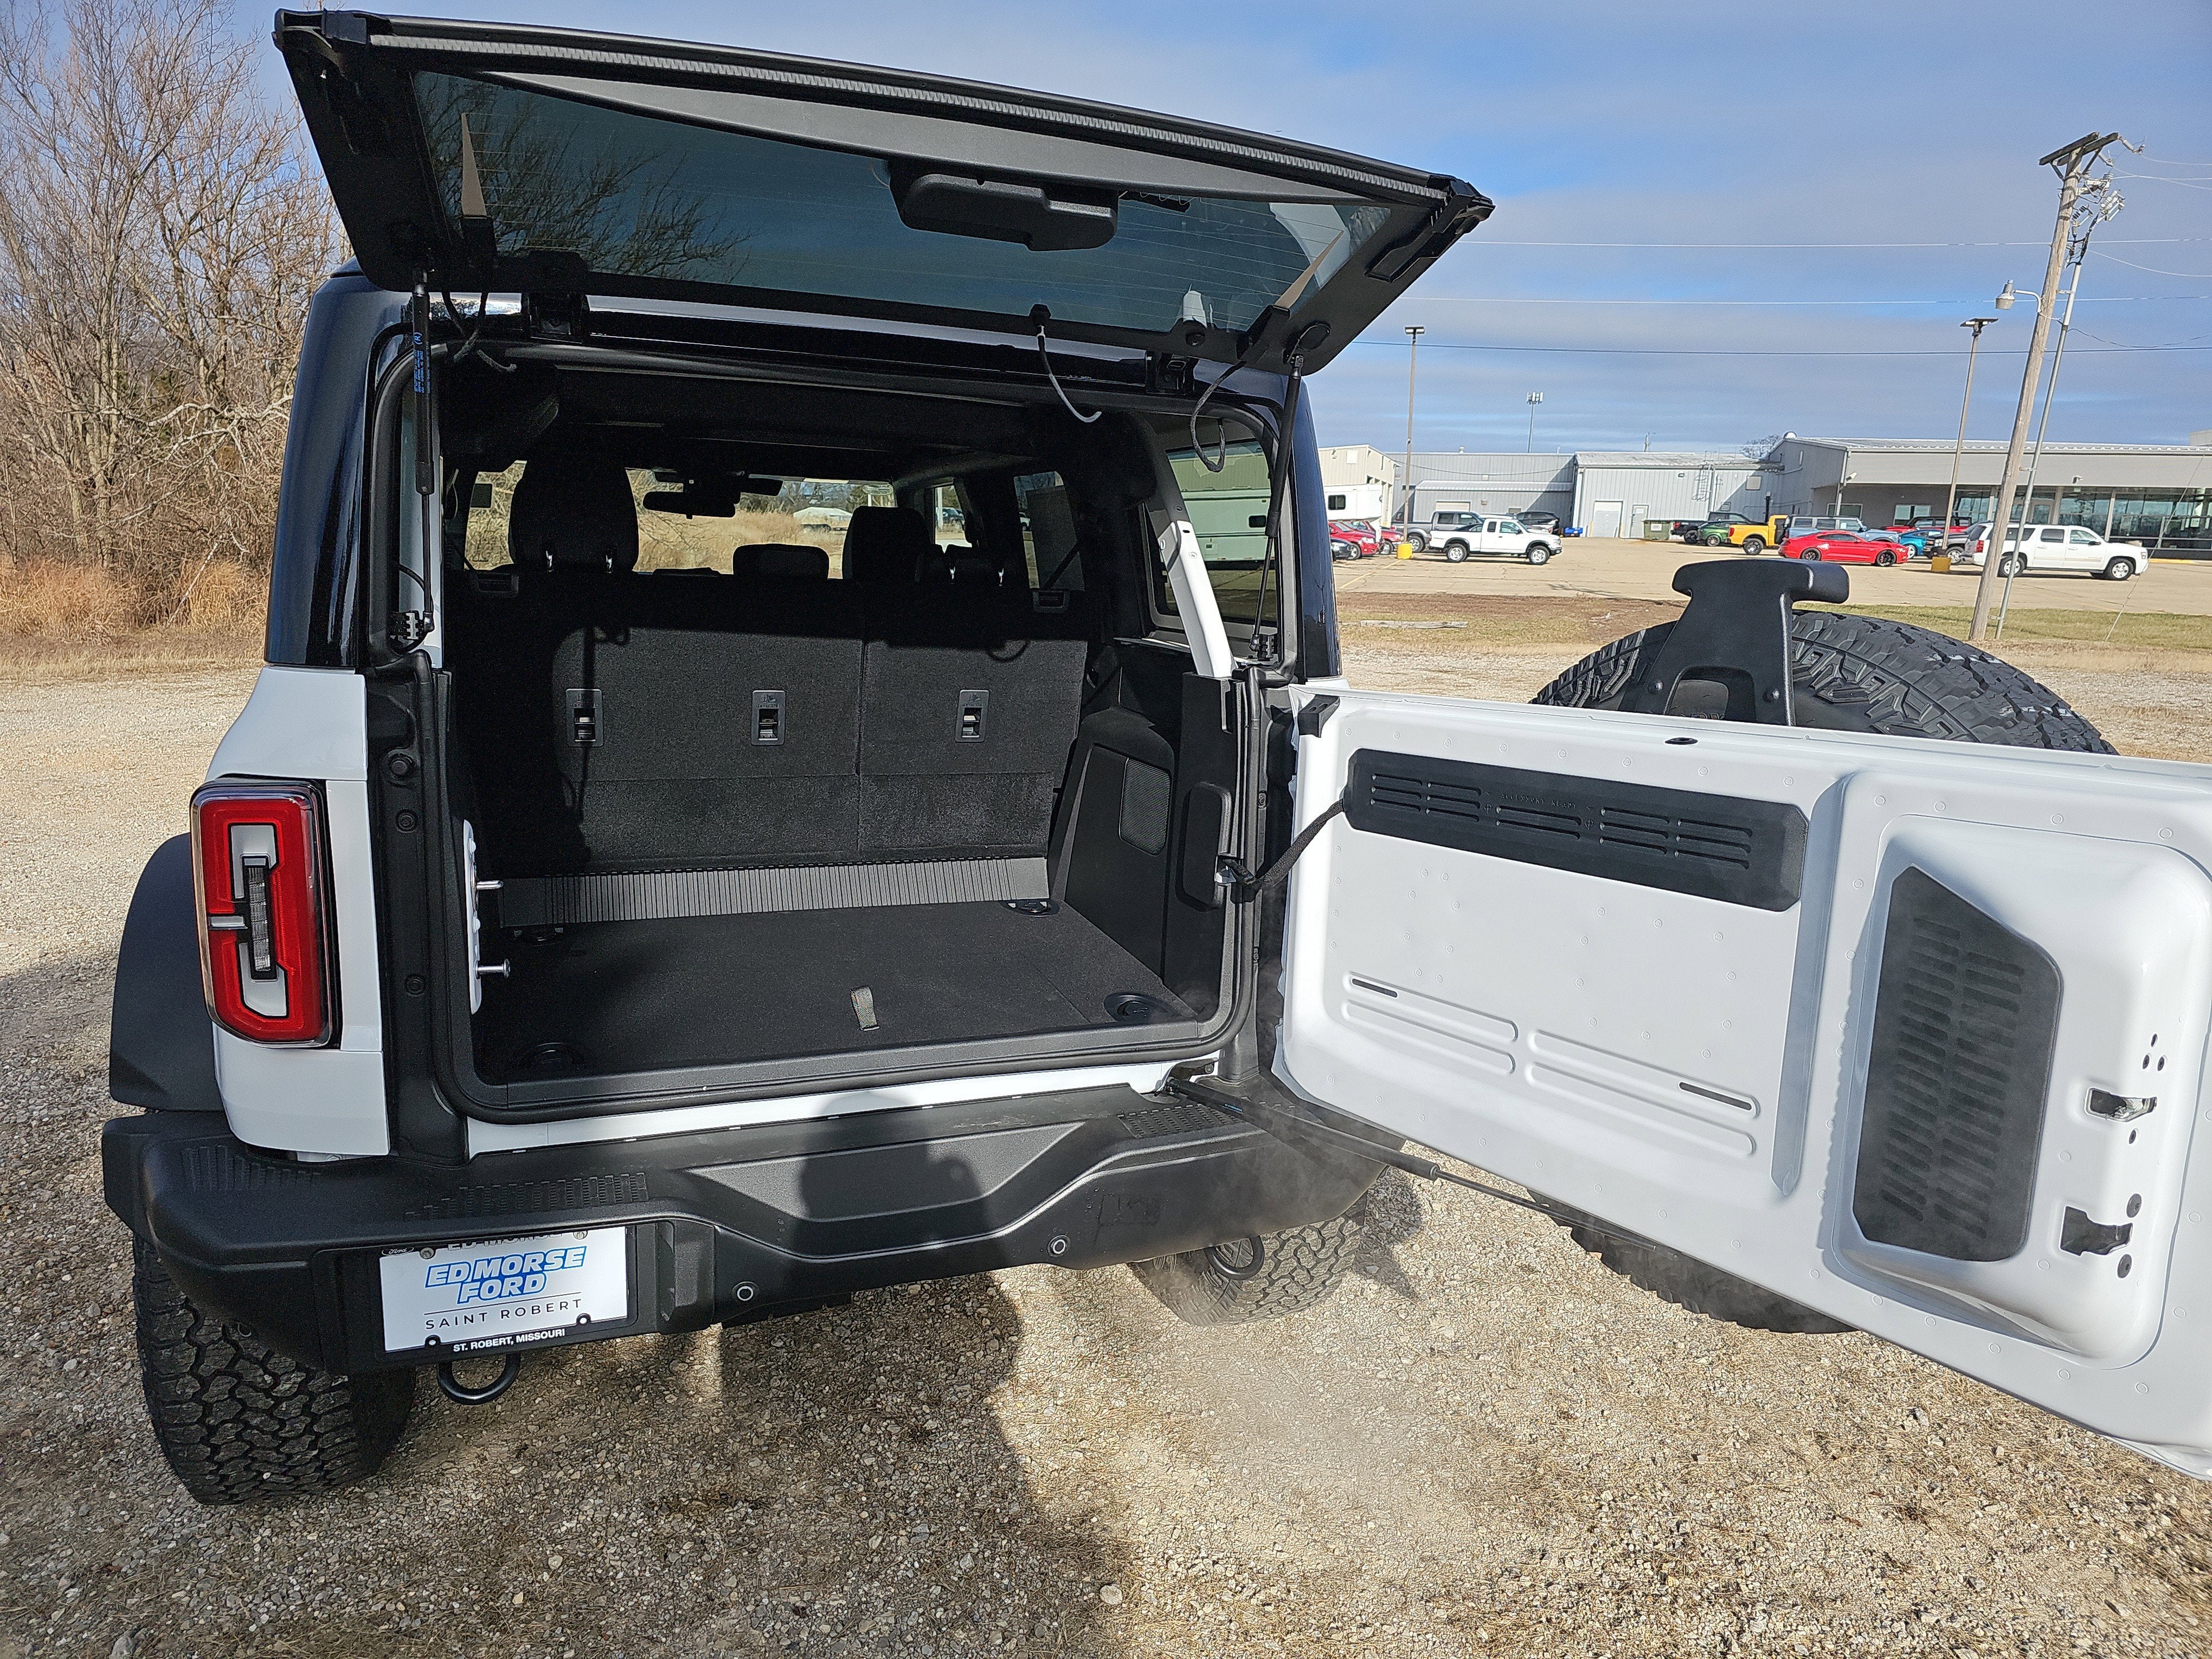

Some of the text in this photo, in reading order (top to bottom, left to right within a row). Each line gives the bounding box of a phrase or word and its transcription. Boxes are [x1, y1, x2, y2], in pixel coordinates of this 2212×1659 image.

[456, 1273, 547, 1304] FORD
[426, 1299, 582, 1329] SAINT ROBERT
[453, 1329, 565, 1352] ST. ROBERT, MISSOURI
